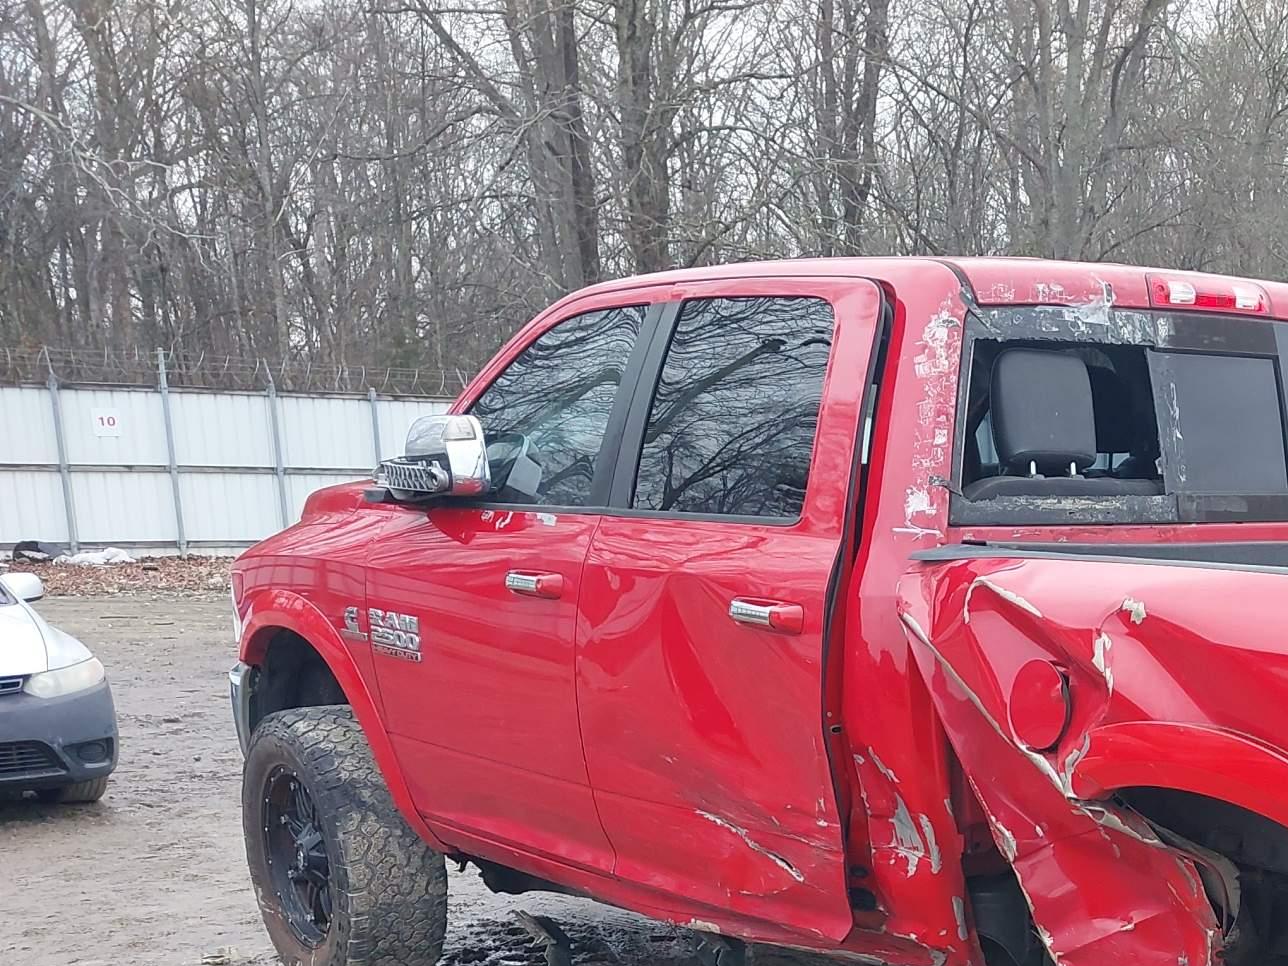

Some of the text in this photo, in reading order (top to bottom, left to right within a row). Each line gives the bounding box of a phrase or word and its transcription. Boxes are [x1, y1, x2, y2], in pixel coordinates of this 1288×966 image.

[98, 416, 116, 427] 10
[368, 607, 419, 633] RAM
[370, 625, 420, 651] 2500
